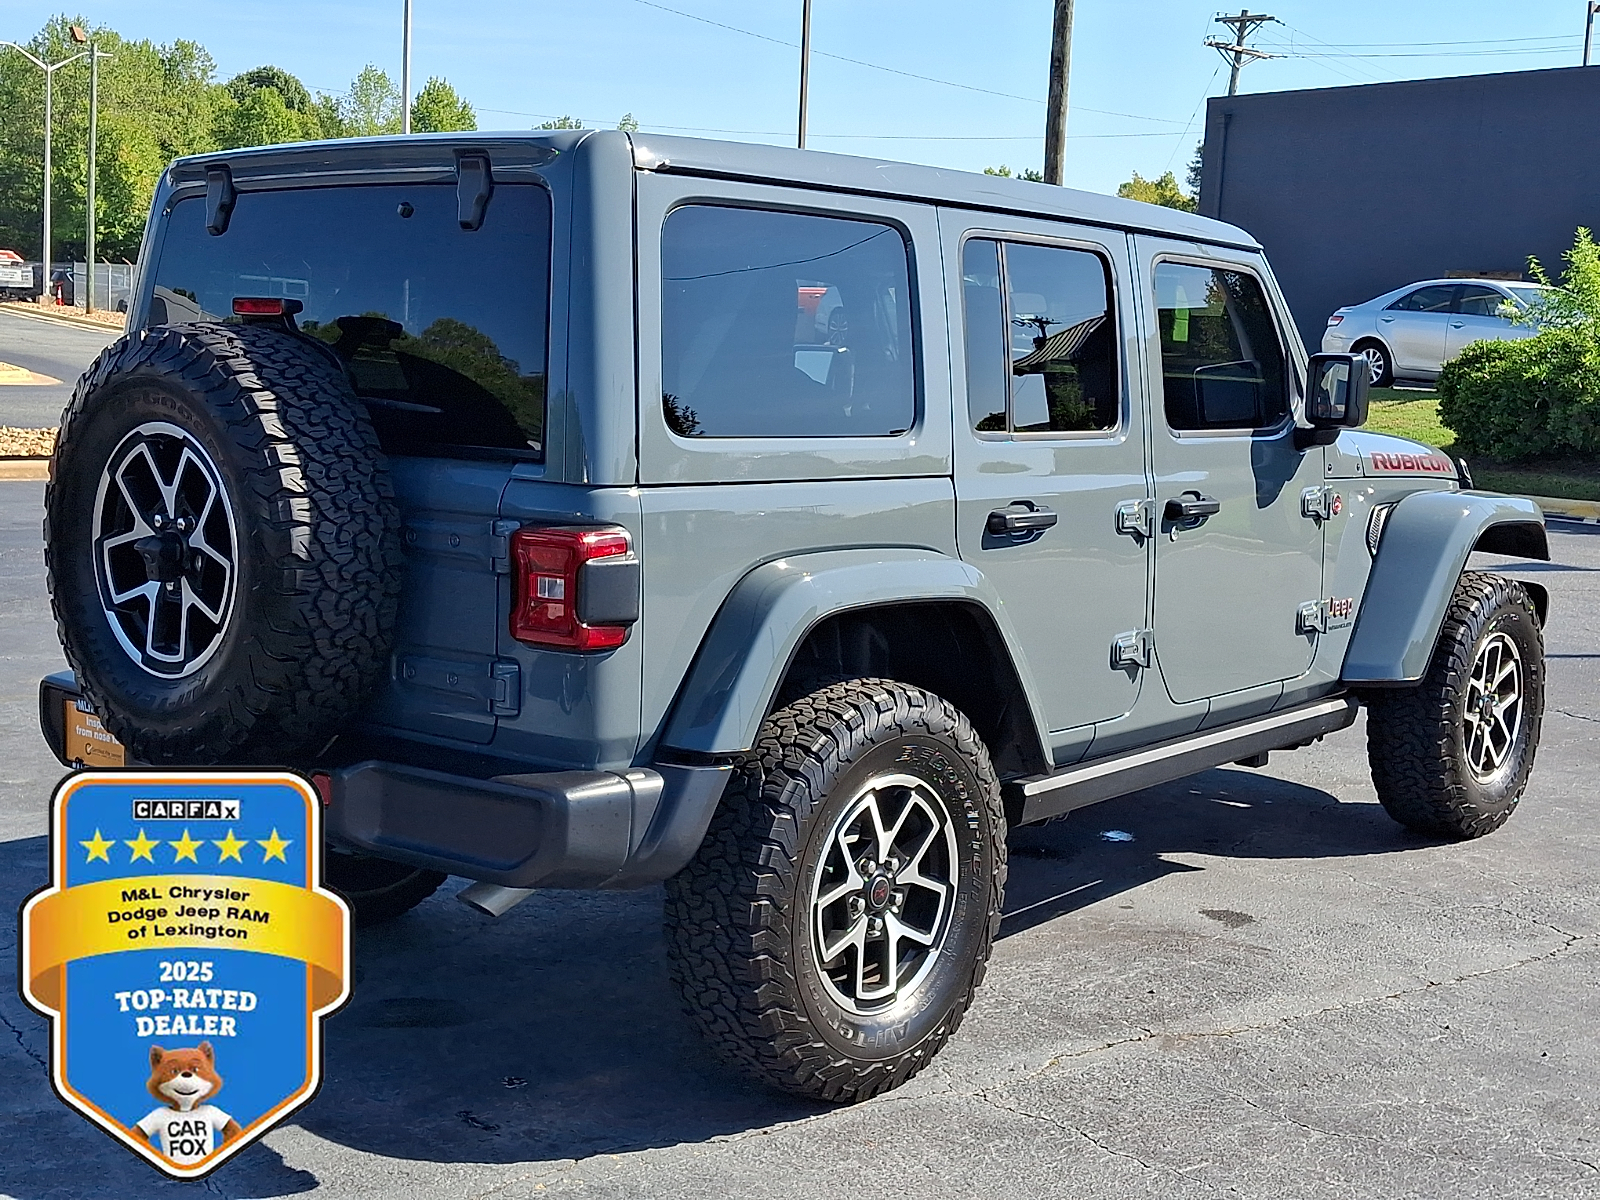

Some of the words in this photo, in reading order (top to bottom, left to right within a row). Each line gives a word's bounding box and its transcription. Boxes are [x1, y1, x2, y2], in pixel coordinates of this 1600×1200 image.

[1370, 451, 1453, 473] RUBICON
[1329, 596, 1353, 620] Jeep
[76, 724, 93, 738] from
[94, 731, 111, 743] nose
[85, 716, 102, 731] Insp
